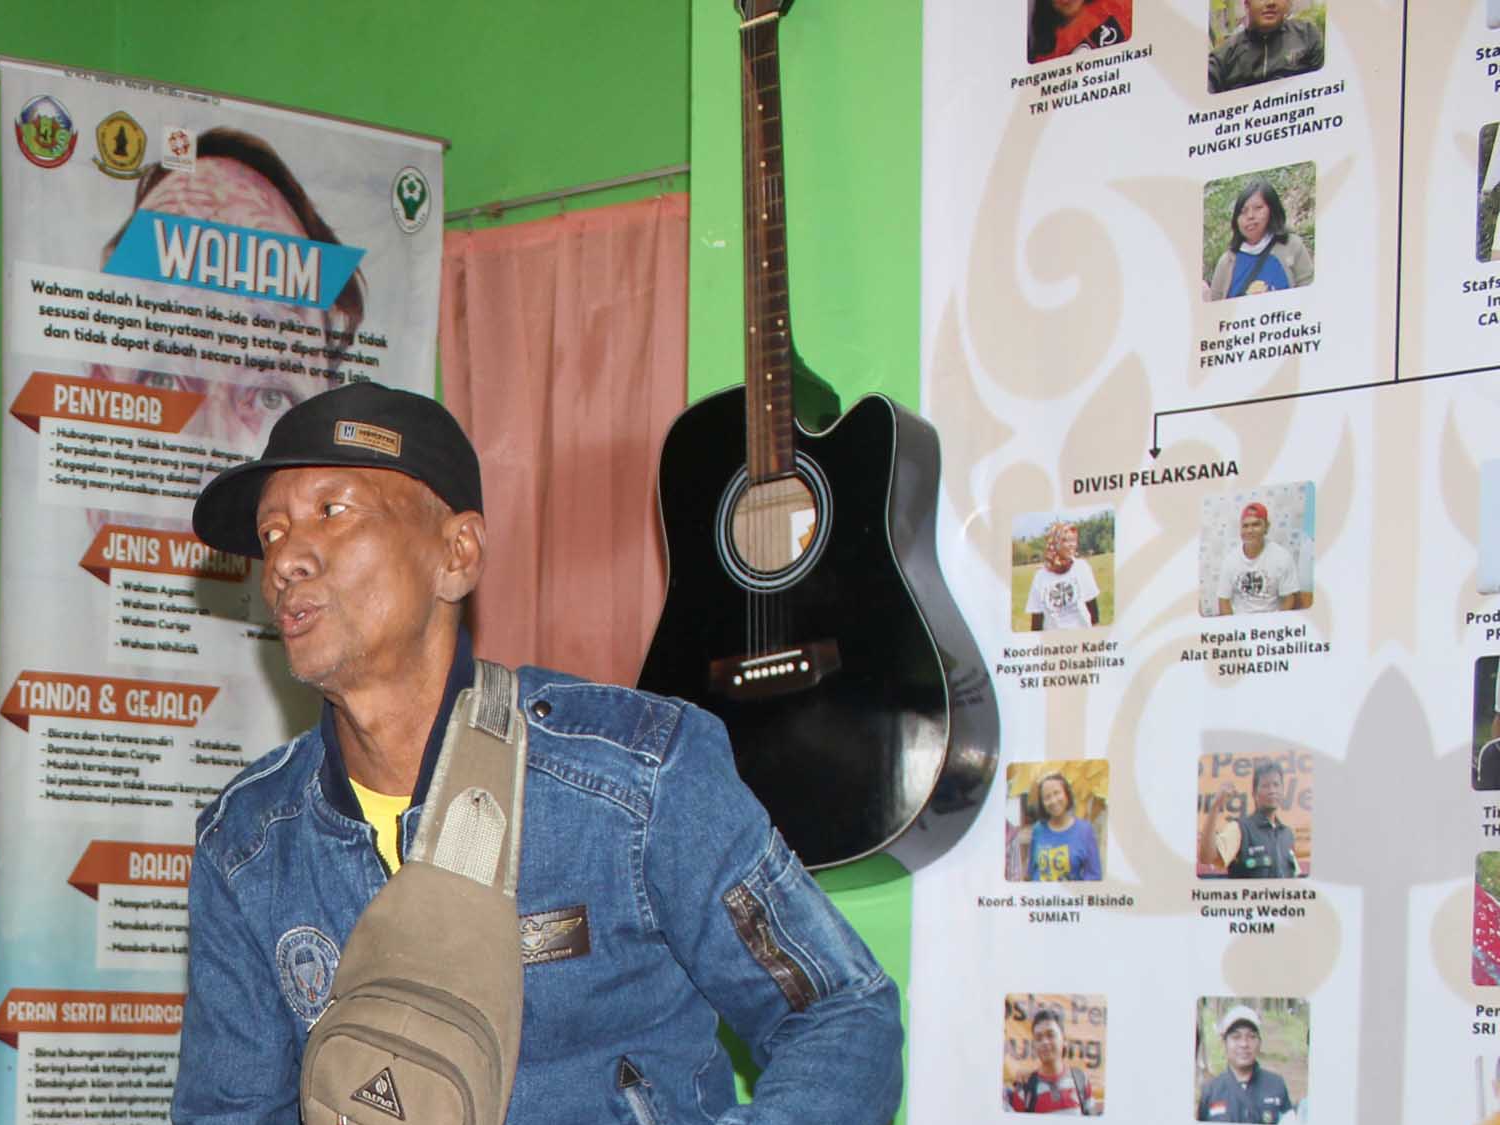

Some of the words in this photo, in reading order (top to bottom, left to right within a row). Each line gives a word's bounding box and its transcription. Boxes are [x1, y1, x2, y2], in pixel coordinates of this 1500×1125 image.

[1476, 46, 1500, 60] Sta
[1010, 63, 1073, 89] Pengawas
[1075, 45, 1154, 73] Komunikasi
[1040, 76, 1079, 98] Media
[1082, 69, 1120, 88] Sosial
[1028, 102, 1049, 115] TRI
[1051, 83, 1132, 112] WULANDARI
[1187, 104, 1249, 126] Manager
[1251, 80, 1345, 111] Administrasi
[1214, 120, 1241, 136] dan
[1244, 104, 1316, 133] Keuangan
[1187, 134, 1242, 158] PUNGKI
[1245, 115, 1343, 148] SUGESTIANTO
[153, 217, 324, 304] WAHAM
[1463, 275, 1500, 293] Stafs
[31, 279, 83, 299] Waham
[87, 288, 132, 306] adalah
[136, 294, 202, 318] keyakinan
[205, 306, 248, 326] ide-ide
[252, 313, 276, 329] dan
[279, 318, 322, 336] pikiran
[358, 330, 388, 348] tidak
[1218, 315, 1256, 333] Front
[1259, 308, 1302, 326] Office
[39, 303, 90, 321] sesusai
[93, 310, 142, 329] dengan
[145, 316, 214, 340] kenyataan
[218, 331, 248, 349] yang
[252, 336, 287, 354] tetap
[1200, 330, 1256, 353] Bengkel
[1259, 322, 1322, 343] Produksi
[44, 324, 70, 339] dan
[74, 328, 107, 345] tidak
[111, 334, 149, 351] dapat
[153, 338, 197, 357] diubah
[201, 348, 241, 366] secara
[244, 353, 276, 371] logis
[279, 359, 306, 375] oleh
[1200, 347, 1245, 368] FENNY
[1248, 339, 1321, 361] ARDIANTY
[53, 383, 163, 425] PENYEBAB
[1073, 474, 1124, 494] DIVISI
[1129, 460, 1239, 488] PELAKSANA
[102, 532, 161, 566] JENIS
[1466, 611, 1500, 624] Prod
[1200, 631, 1246, 645] Kepala
[1250, 625, 1306, 644] Bengkel
[1003, 643, 1078, 658] Koordinator
[1082, 640, 1119, 653] Kader
[1181, 648, 1208, 662] Alat
[1212, 646, 1252, 659] Bantu
[1256, 640, 1330, 657] Disabilitas
[996, 659, 1056, 675] Posyandu
[1059, 655, 1125, 670] Disabilitas
[1218, 661, 1289, 676] SUHAEDIN
[1020, 677, 1039, 689] SRI
[1042, 673, 1100, 687] EKOWATI
[17, 680, 91, 714] TANDA
[99, 683, 117, 715] &
[125, 689, 204, 722] GEJALA
[129, 851, 193, 881] BAHAY
[978, 895, 1017, 908] Koord.
[1020, 894, 1084, 907] Sosialisasi
[1088, 894, 1134, 907] Bisindo
[1191, 889, 1238, 901] Humas
[1242, 888, 1316, 901] Pariwisata
[1028, 911, 1080, 923] SUMIATI
[1200, 906, 1253, 919] Gunung
[1257, 905, 1305, 917] Wedon
[1229, 922, 1275, 934] ROKIM
[7, 1001, 57, 1022] PERAN
[62, 1002, 106, 1023] SERTA
[110, 1004, 183, 1024] KELUARGA
[1472, 1021, 1496, 1035] SRI
